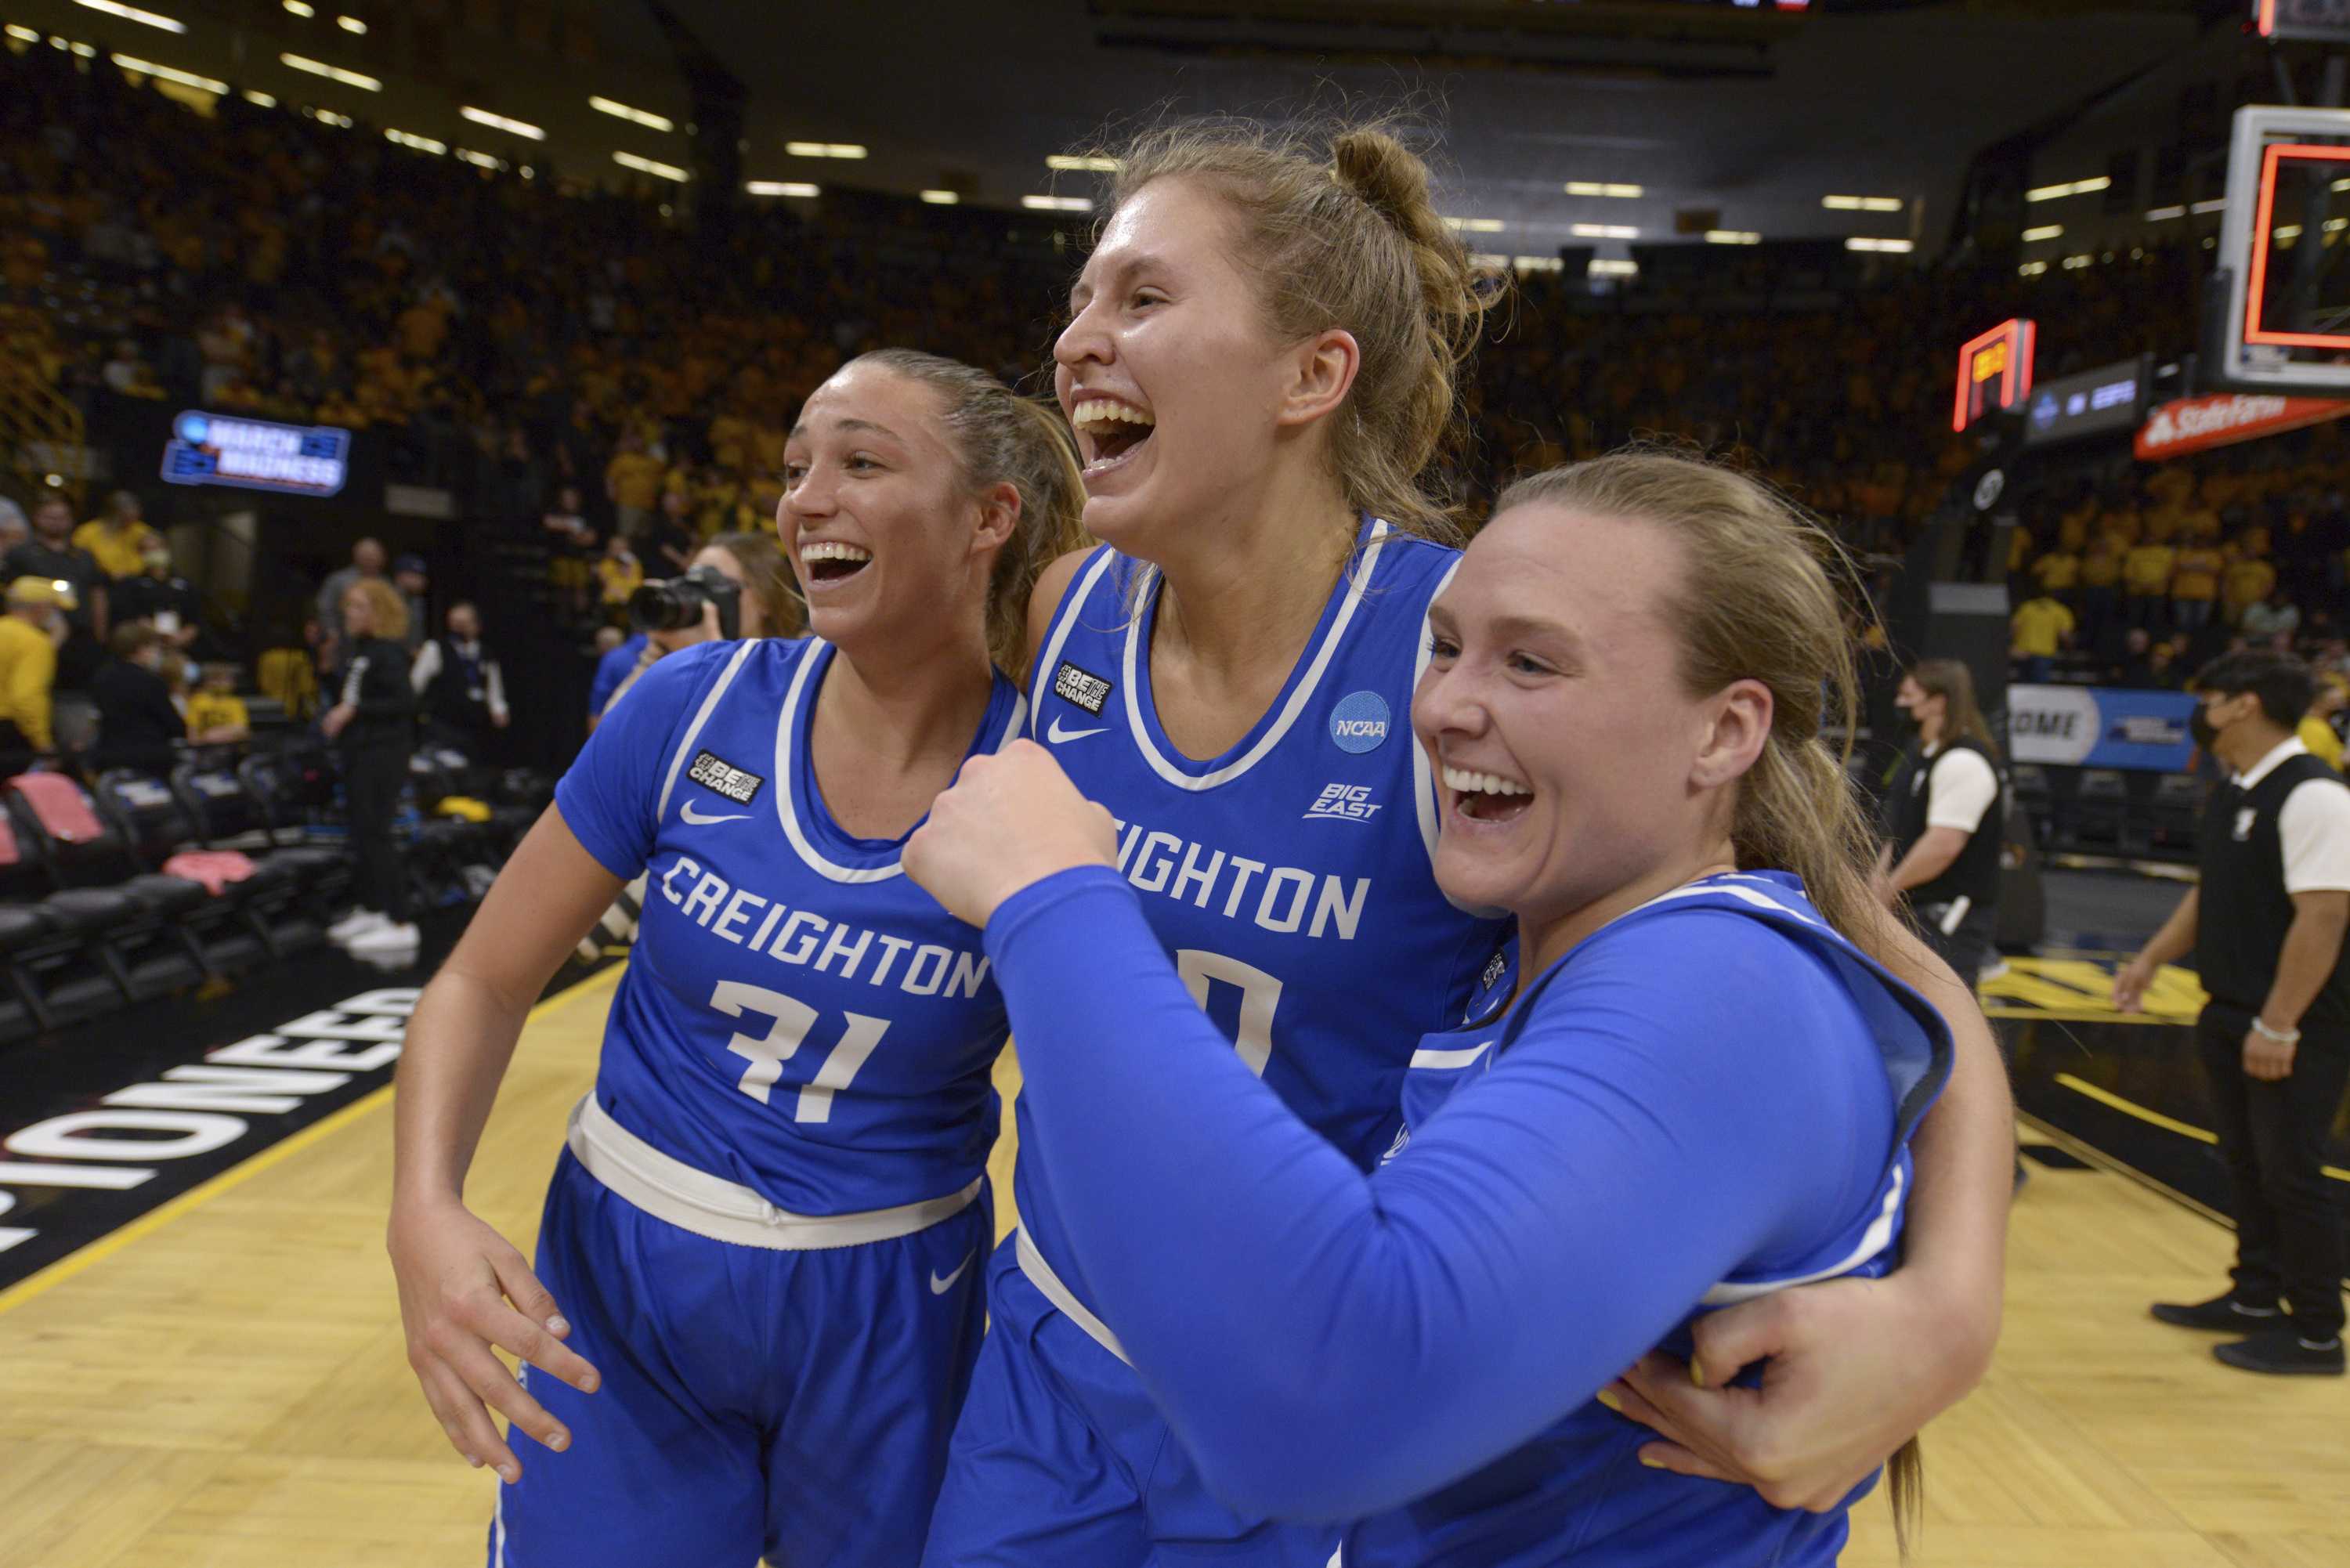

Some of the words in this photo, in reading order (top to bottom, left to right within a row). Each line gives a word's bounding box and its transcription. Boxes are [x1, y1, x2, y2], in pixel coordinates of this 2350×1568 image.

[1055, 681, 1101, 712] CHANGE
[1336, 720, 1386, 737] NCAA
[2008, 708, 2081, 740] OME
[689, 767, 753, 801] CHANGE
[1319, 783, 1372, 802] BIG
[1309, 797, 1383, 818] EAST
[1114, 818, 1372, 940] IGHTON
[662, 857, 992, 999] CREIGHTON
[709, 980, 891, 1123] 31
[0, 988, 424, 1253] IONEE
